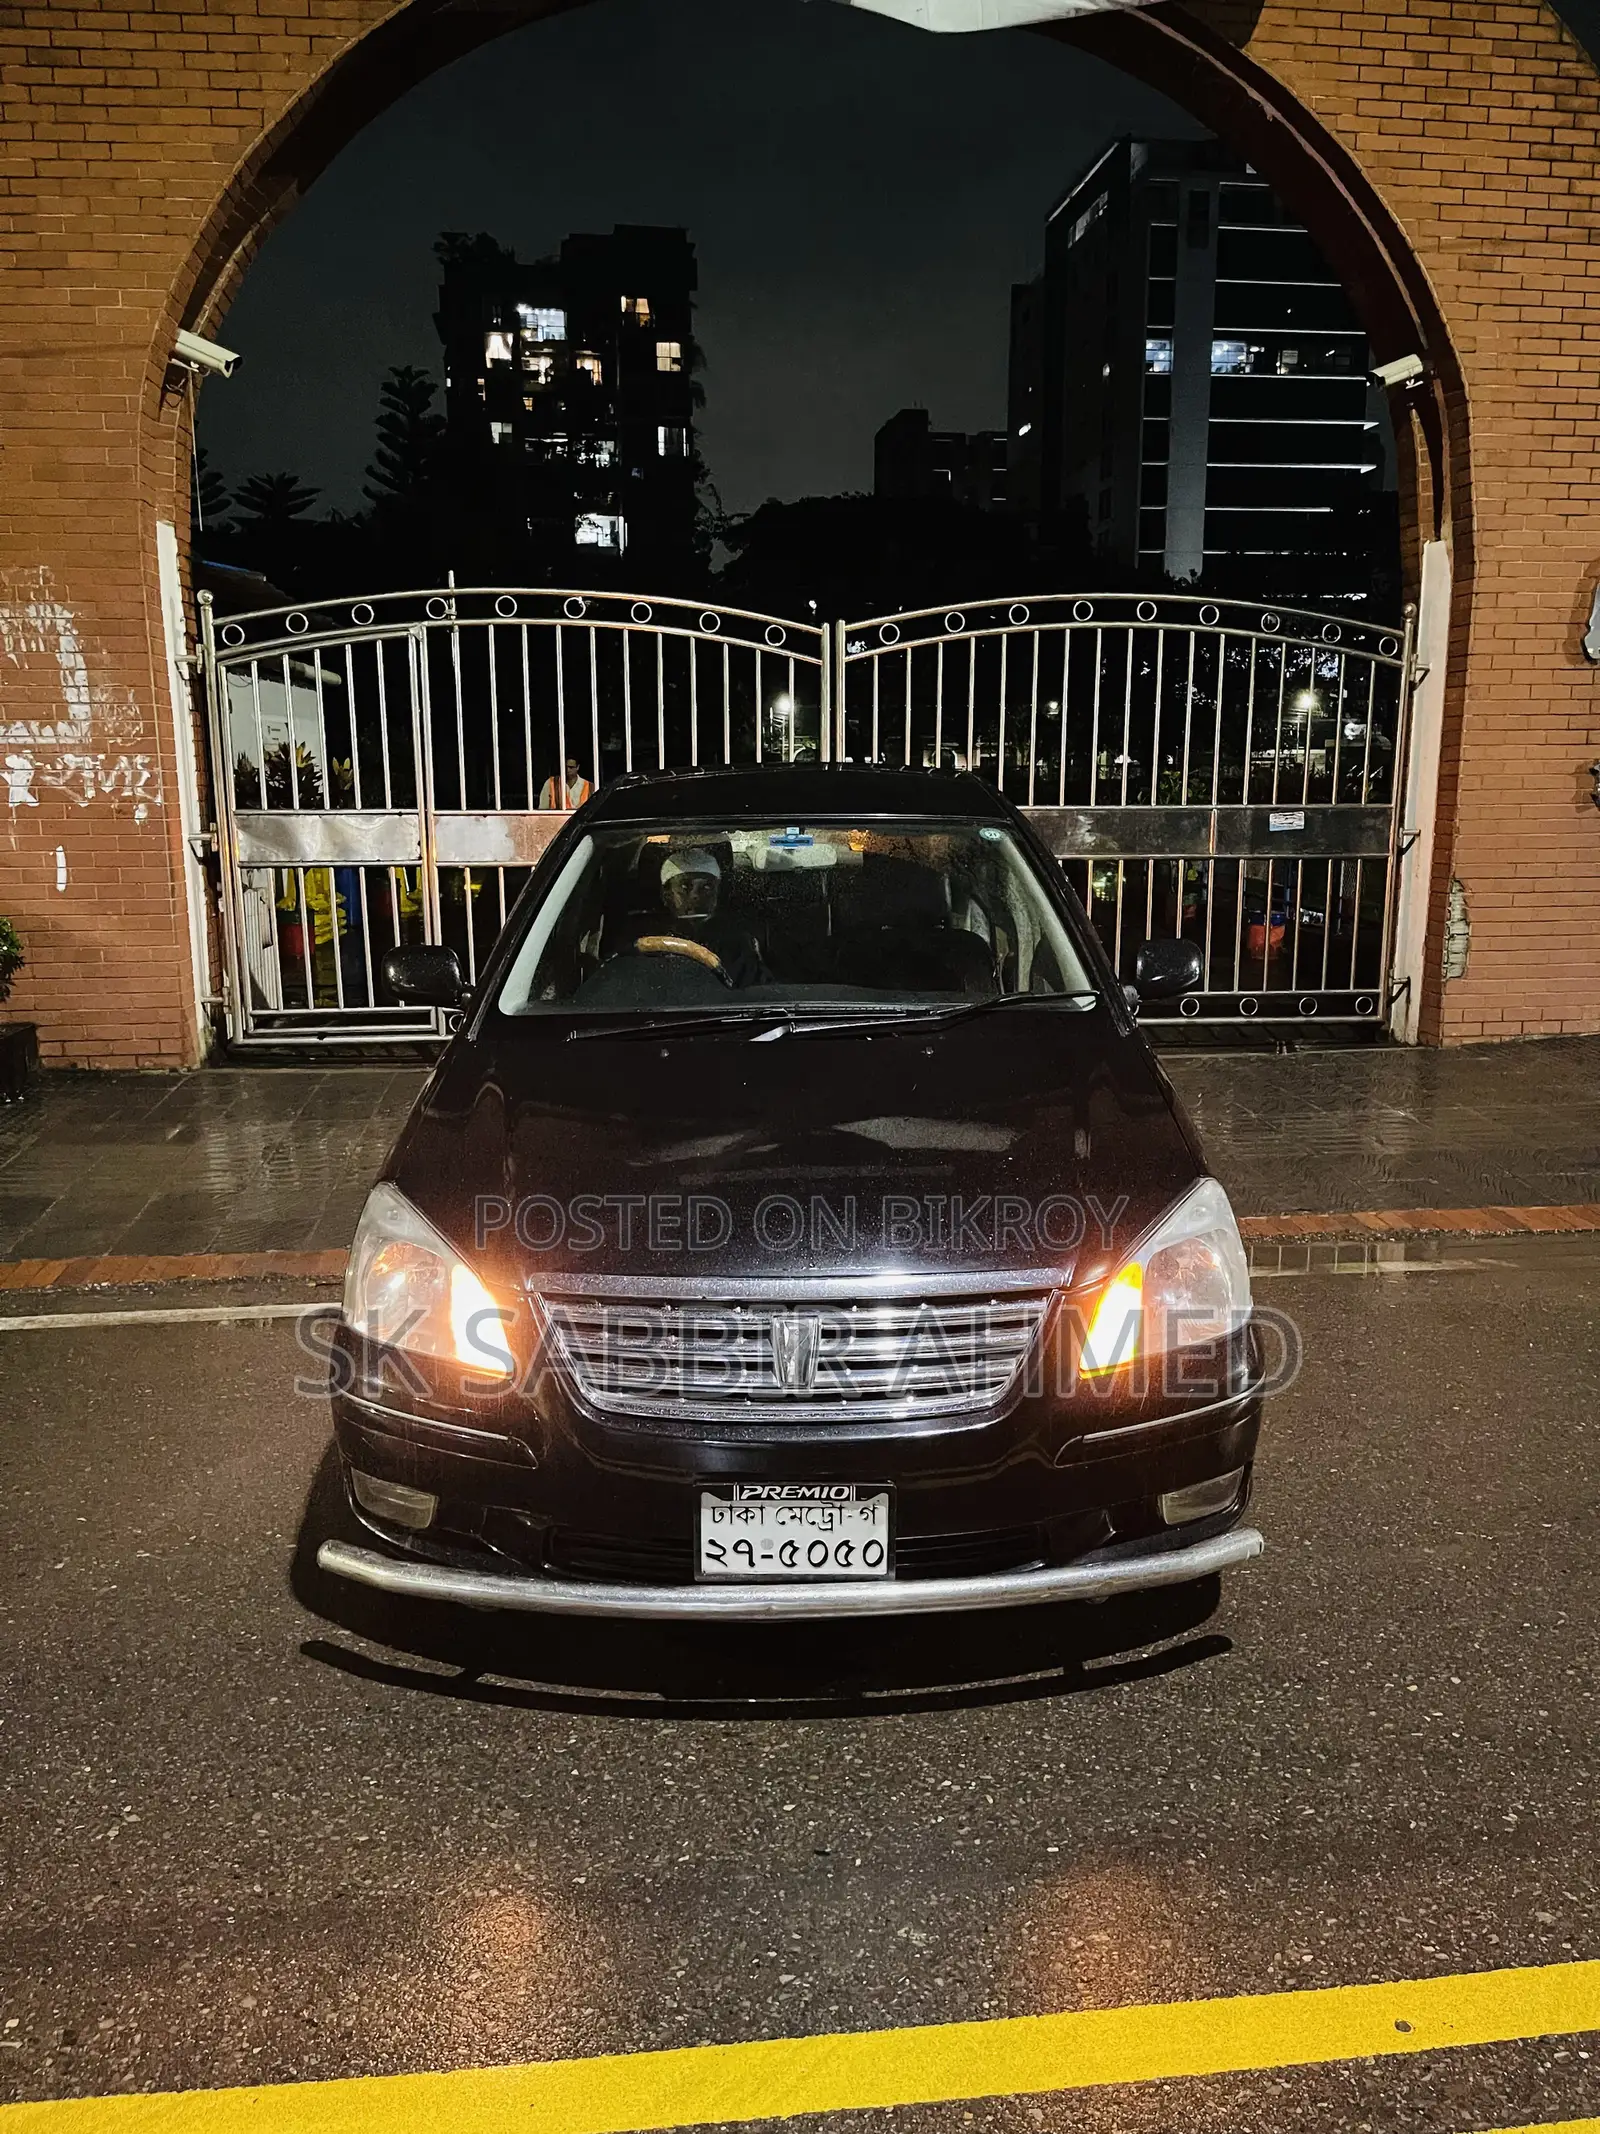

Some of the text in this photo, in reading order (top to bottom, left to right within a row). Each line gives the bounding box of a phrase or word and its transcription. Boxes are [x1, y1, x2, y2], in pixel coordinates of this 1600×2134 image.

[740, 1485, 850, 1500] PREMIO
[711, 1504, 765, 1526] ঢাকা
[705, 1538, 884, 1568] ২৭-৫০৫০
